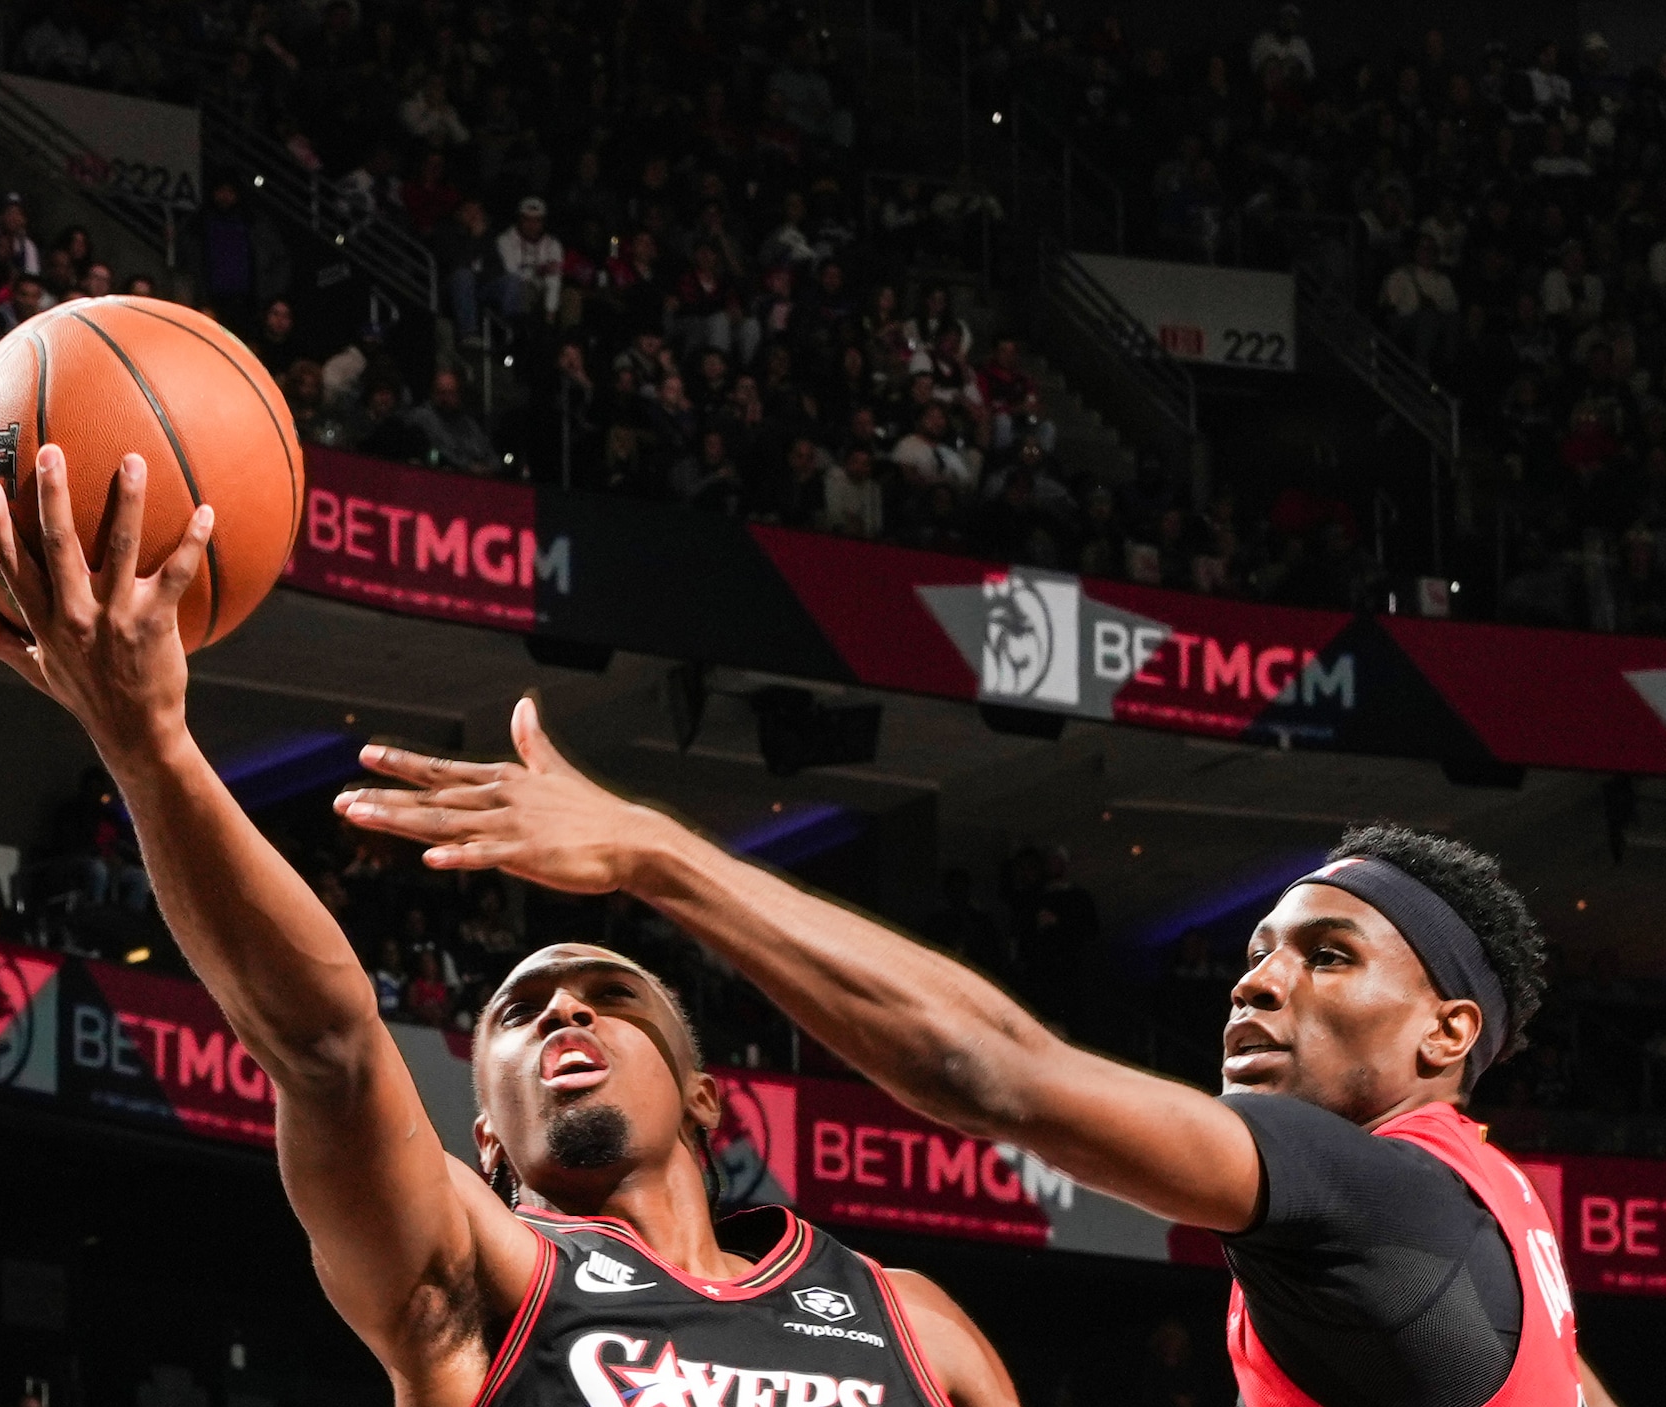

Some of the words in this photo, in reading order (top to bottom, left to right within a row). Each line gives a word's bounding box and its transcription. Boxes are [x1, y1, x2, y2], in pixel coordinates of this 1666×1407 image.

[1223, 328, 1287, 368] 222
[306, 489, 573, 595] BETMGM
[1093, 620, 1355, 708] BETMGM
[586, 1250, 637, 1286] NIKE
